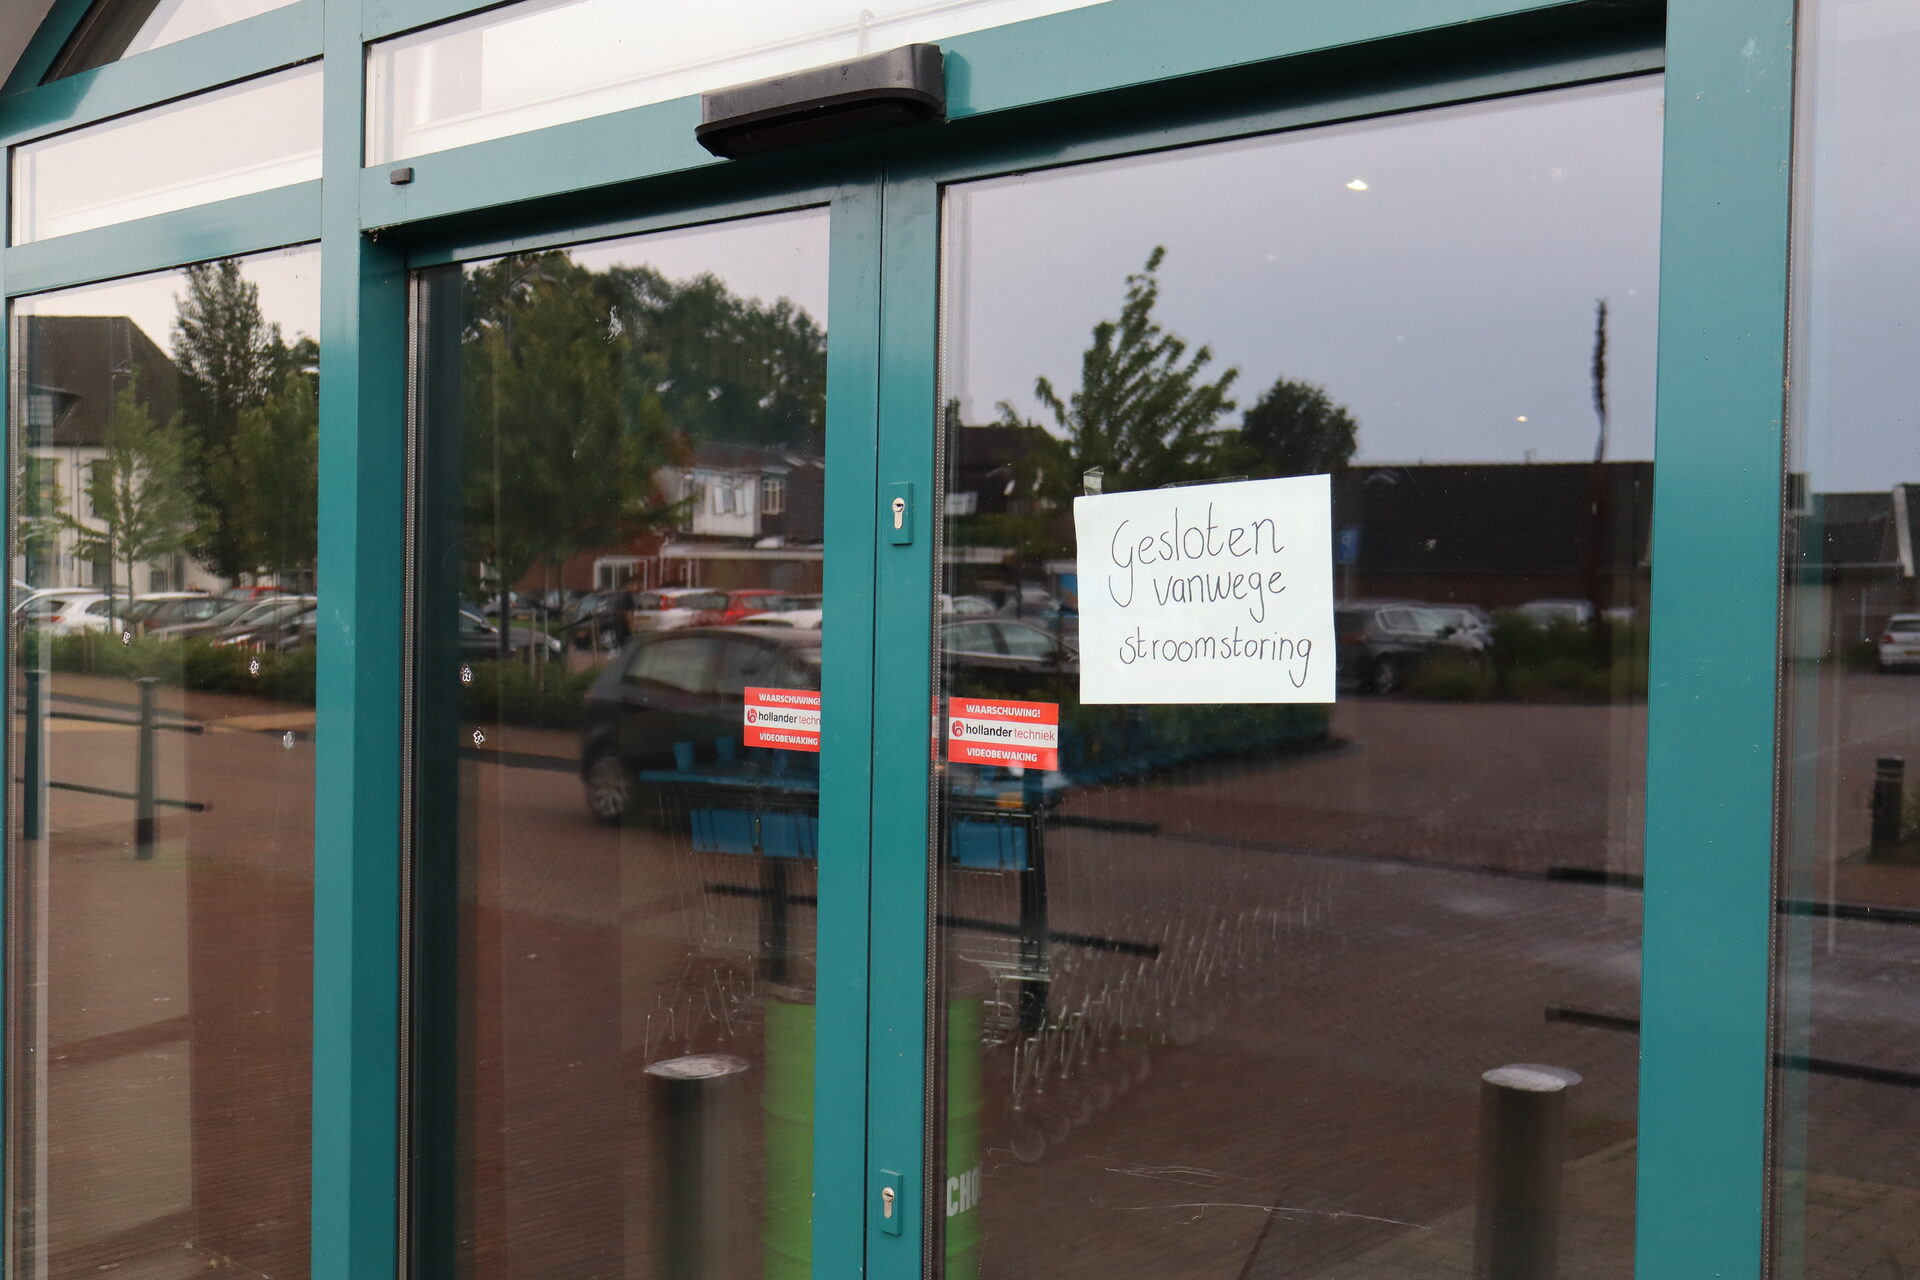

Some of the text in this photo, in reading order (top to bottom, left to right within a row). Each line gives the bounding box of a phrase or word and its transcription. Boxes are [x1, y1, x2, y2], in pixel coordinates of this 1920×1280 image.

[1108, 501, 1285, 608] Gesloten
[1153, 571, 1286, 624] vanwege
[1119, 626, 1312, 688] stroomstoring
[758, 711, 798, 724] hollander
[965, 704, 1040, 718] WAARSCHUWING!
[759, 733, 818, 745] VIDEOBEWAKING
[965, 723, 1055, 742] hollander techniek
[966, 748, 1037, 762] VIDEOBEWAKING
